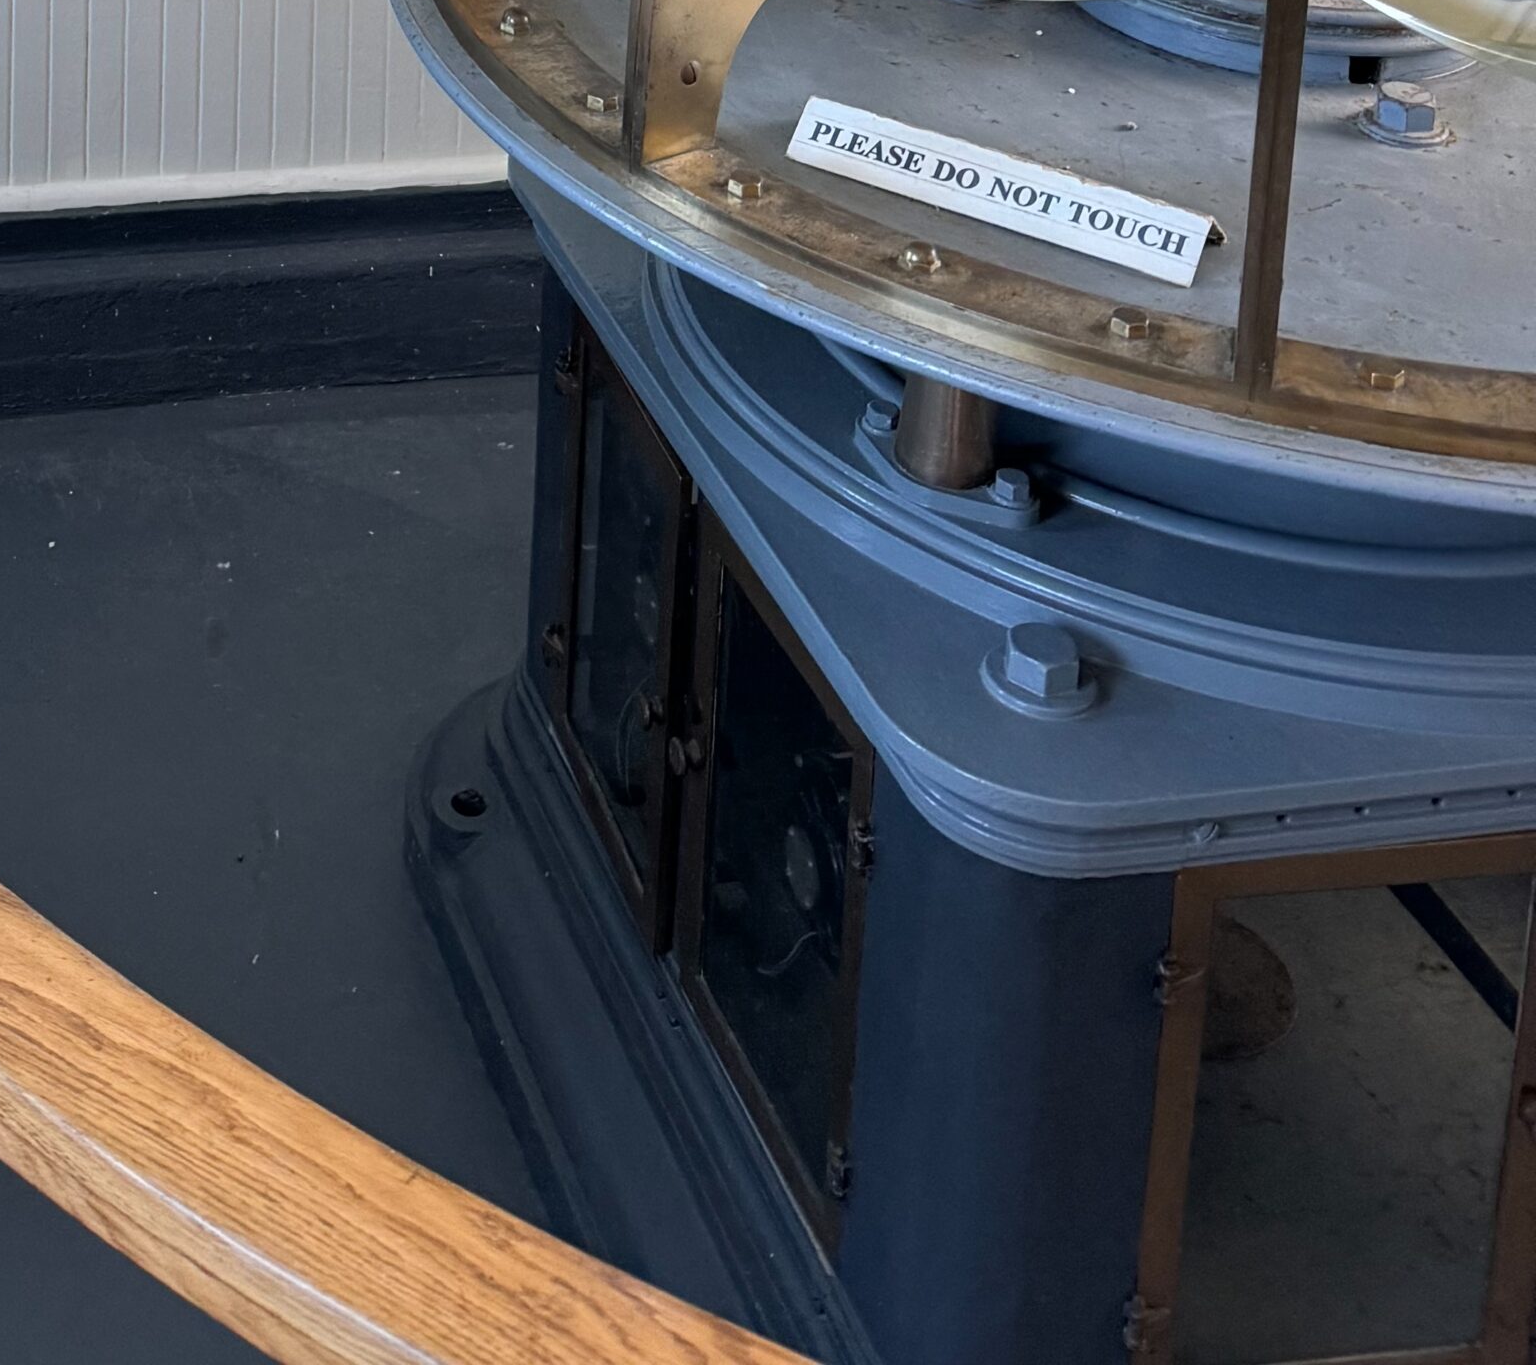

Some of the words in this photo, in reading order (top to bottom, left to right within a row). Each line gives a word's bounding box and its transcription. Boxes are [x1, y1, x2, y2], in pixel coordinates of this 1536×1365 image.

[807, 120, 926, 174] PLEASE
[930, 158, 981, 190] DO
[988, 175, 1061, 215] NOT
[1068, 200, 1190, 257] TOUCH
